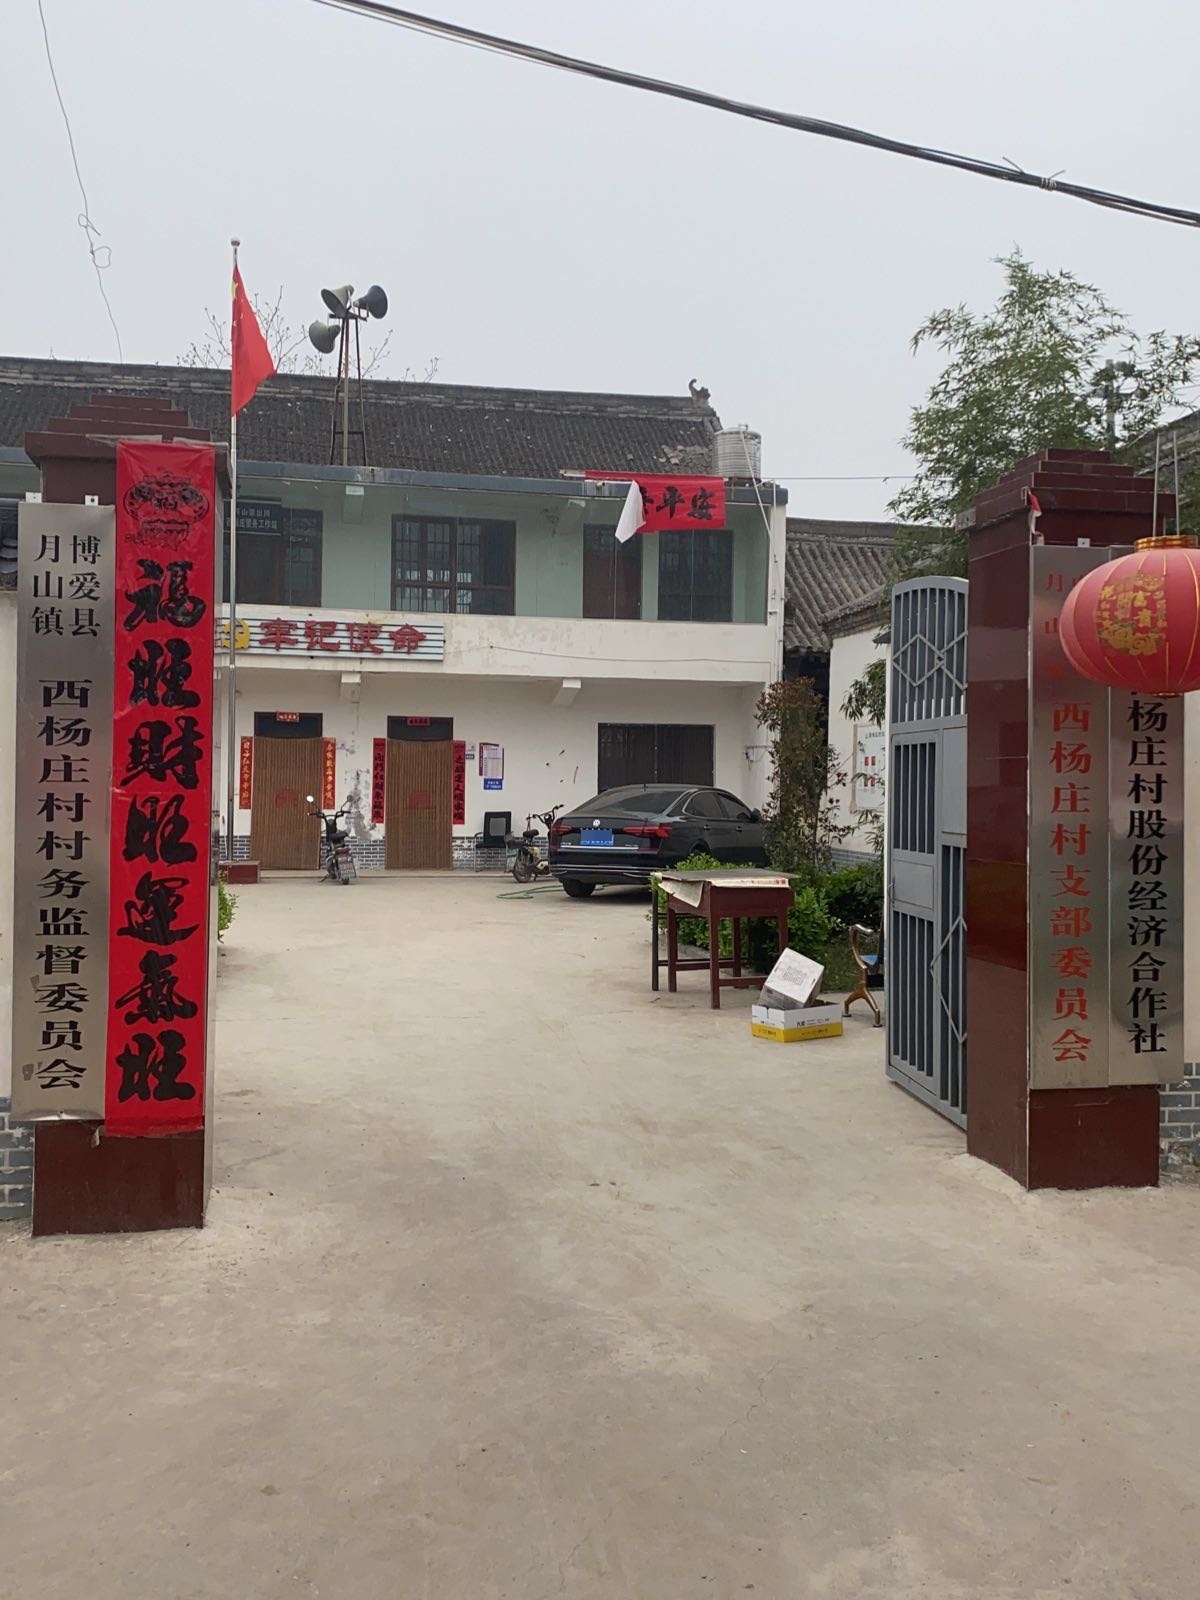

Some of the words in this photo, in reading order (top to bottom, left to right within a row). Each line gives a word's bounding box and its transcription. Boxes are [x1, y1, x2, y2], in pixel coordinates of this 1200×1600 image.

[32, 533, 65, 637] 月山镇
[69, 534, 101, 638] 博爱县
[258, 617, 427, 655] 牢记使命
[35, 678, 92, 1090] 西杨庄村村务监督委员会
[1049, 701, 1092, 1063] 西杨庄村支部委员会
[1127, 691, 1168, 1053] 杨庄村股份经济合作社
